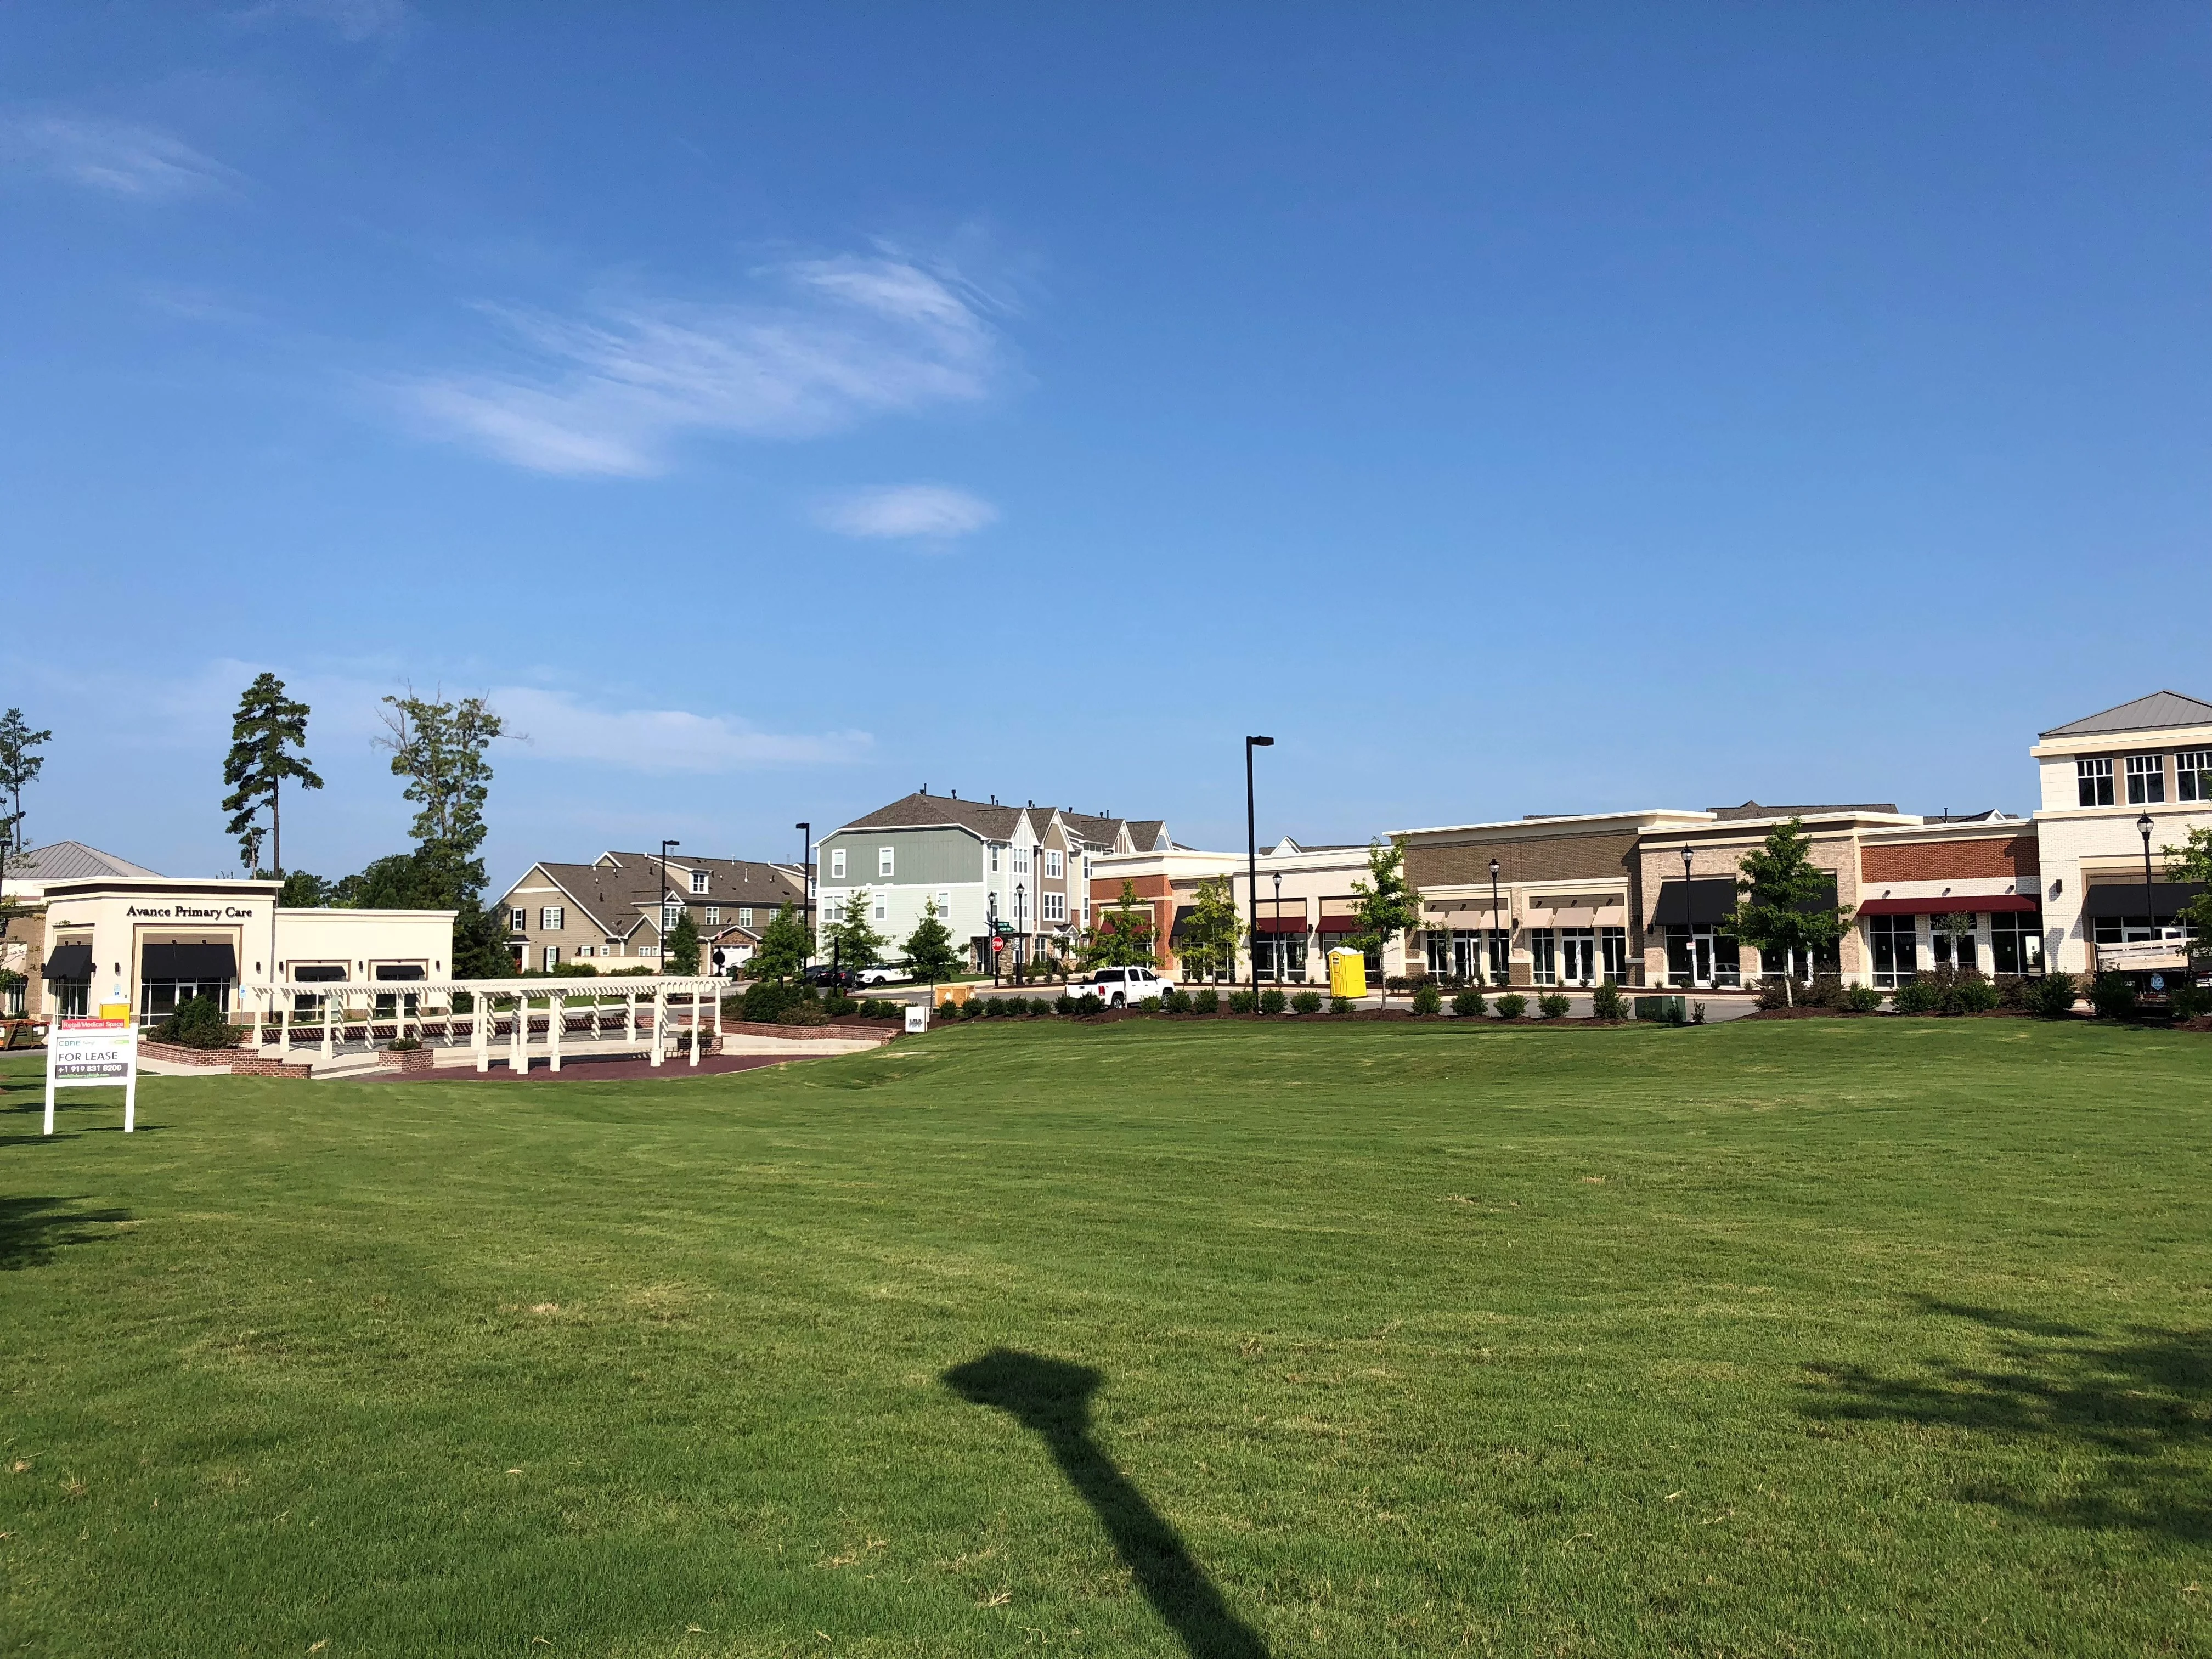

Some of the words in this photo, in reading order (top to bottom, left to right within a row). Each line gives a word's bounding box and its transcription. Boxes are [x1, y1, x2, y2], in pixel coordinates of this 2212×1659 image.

[126, 905, 171, 917] Avance
[175, 906, 222, 921] Primary
[225, 907, 252, 918] Care
[59, 1053, 81, 1062] FOR
[85, 1052, 117, 1060] LEASE
